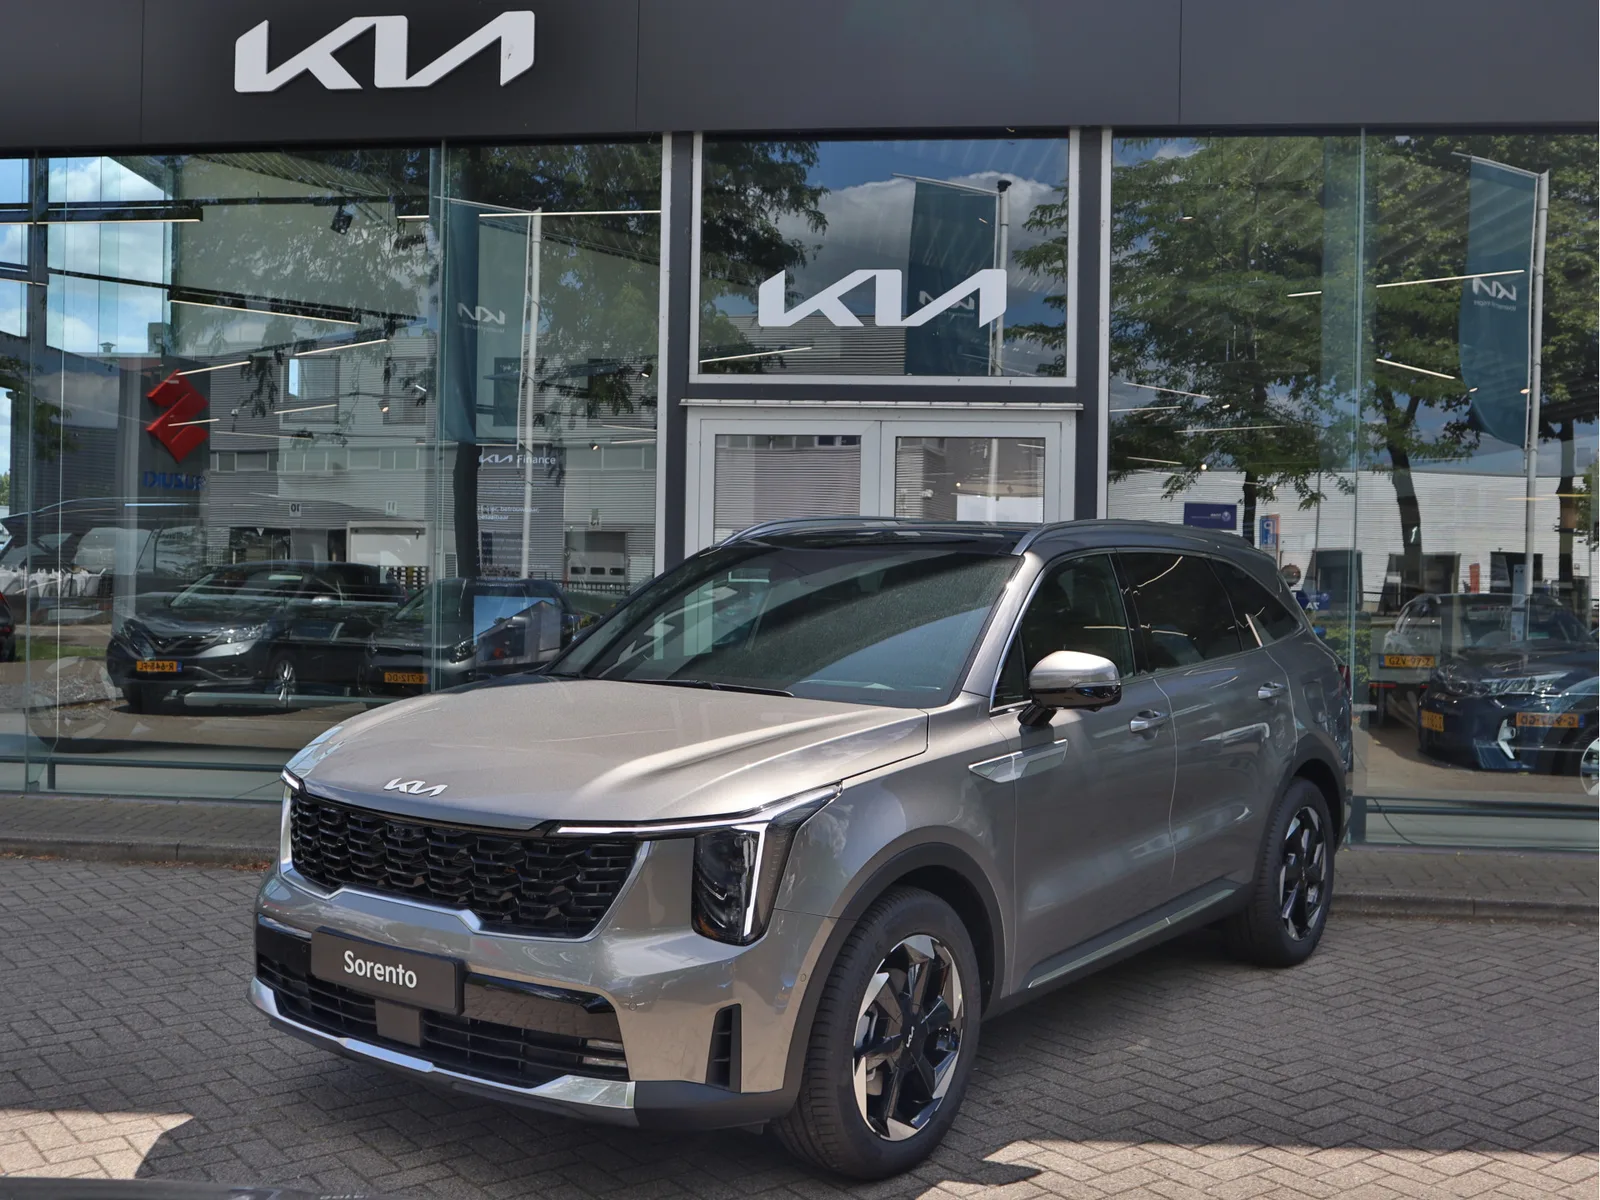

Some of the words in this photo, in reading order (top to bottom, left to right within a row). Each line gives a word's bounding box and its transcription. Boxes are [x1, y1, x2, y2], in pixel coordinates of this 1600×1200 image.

[234, 10, 536, 92] KIA
[758, 269, 1007, 328] KIA
[479, 454, 513, 463] KIA
[383, 777, 448, 797] KIA
[343, 950, 418, 989] Sorento
